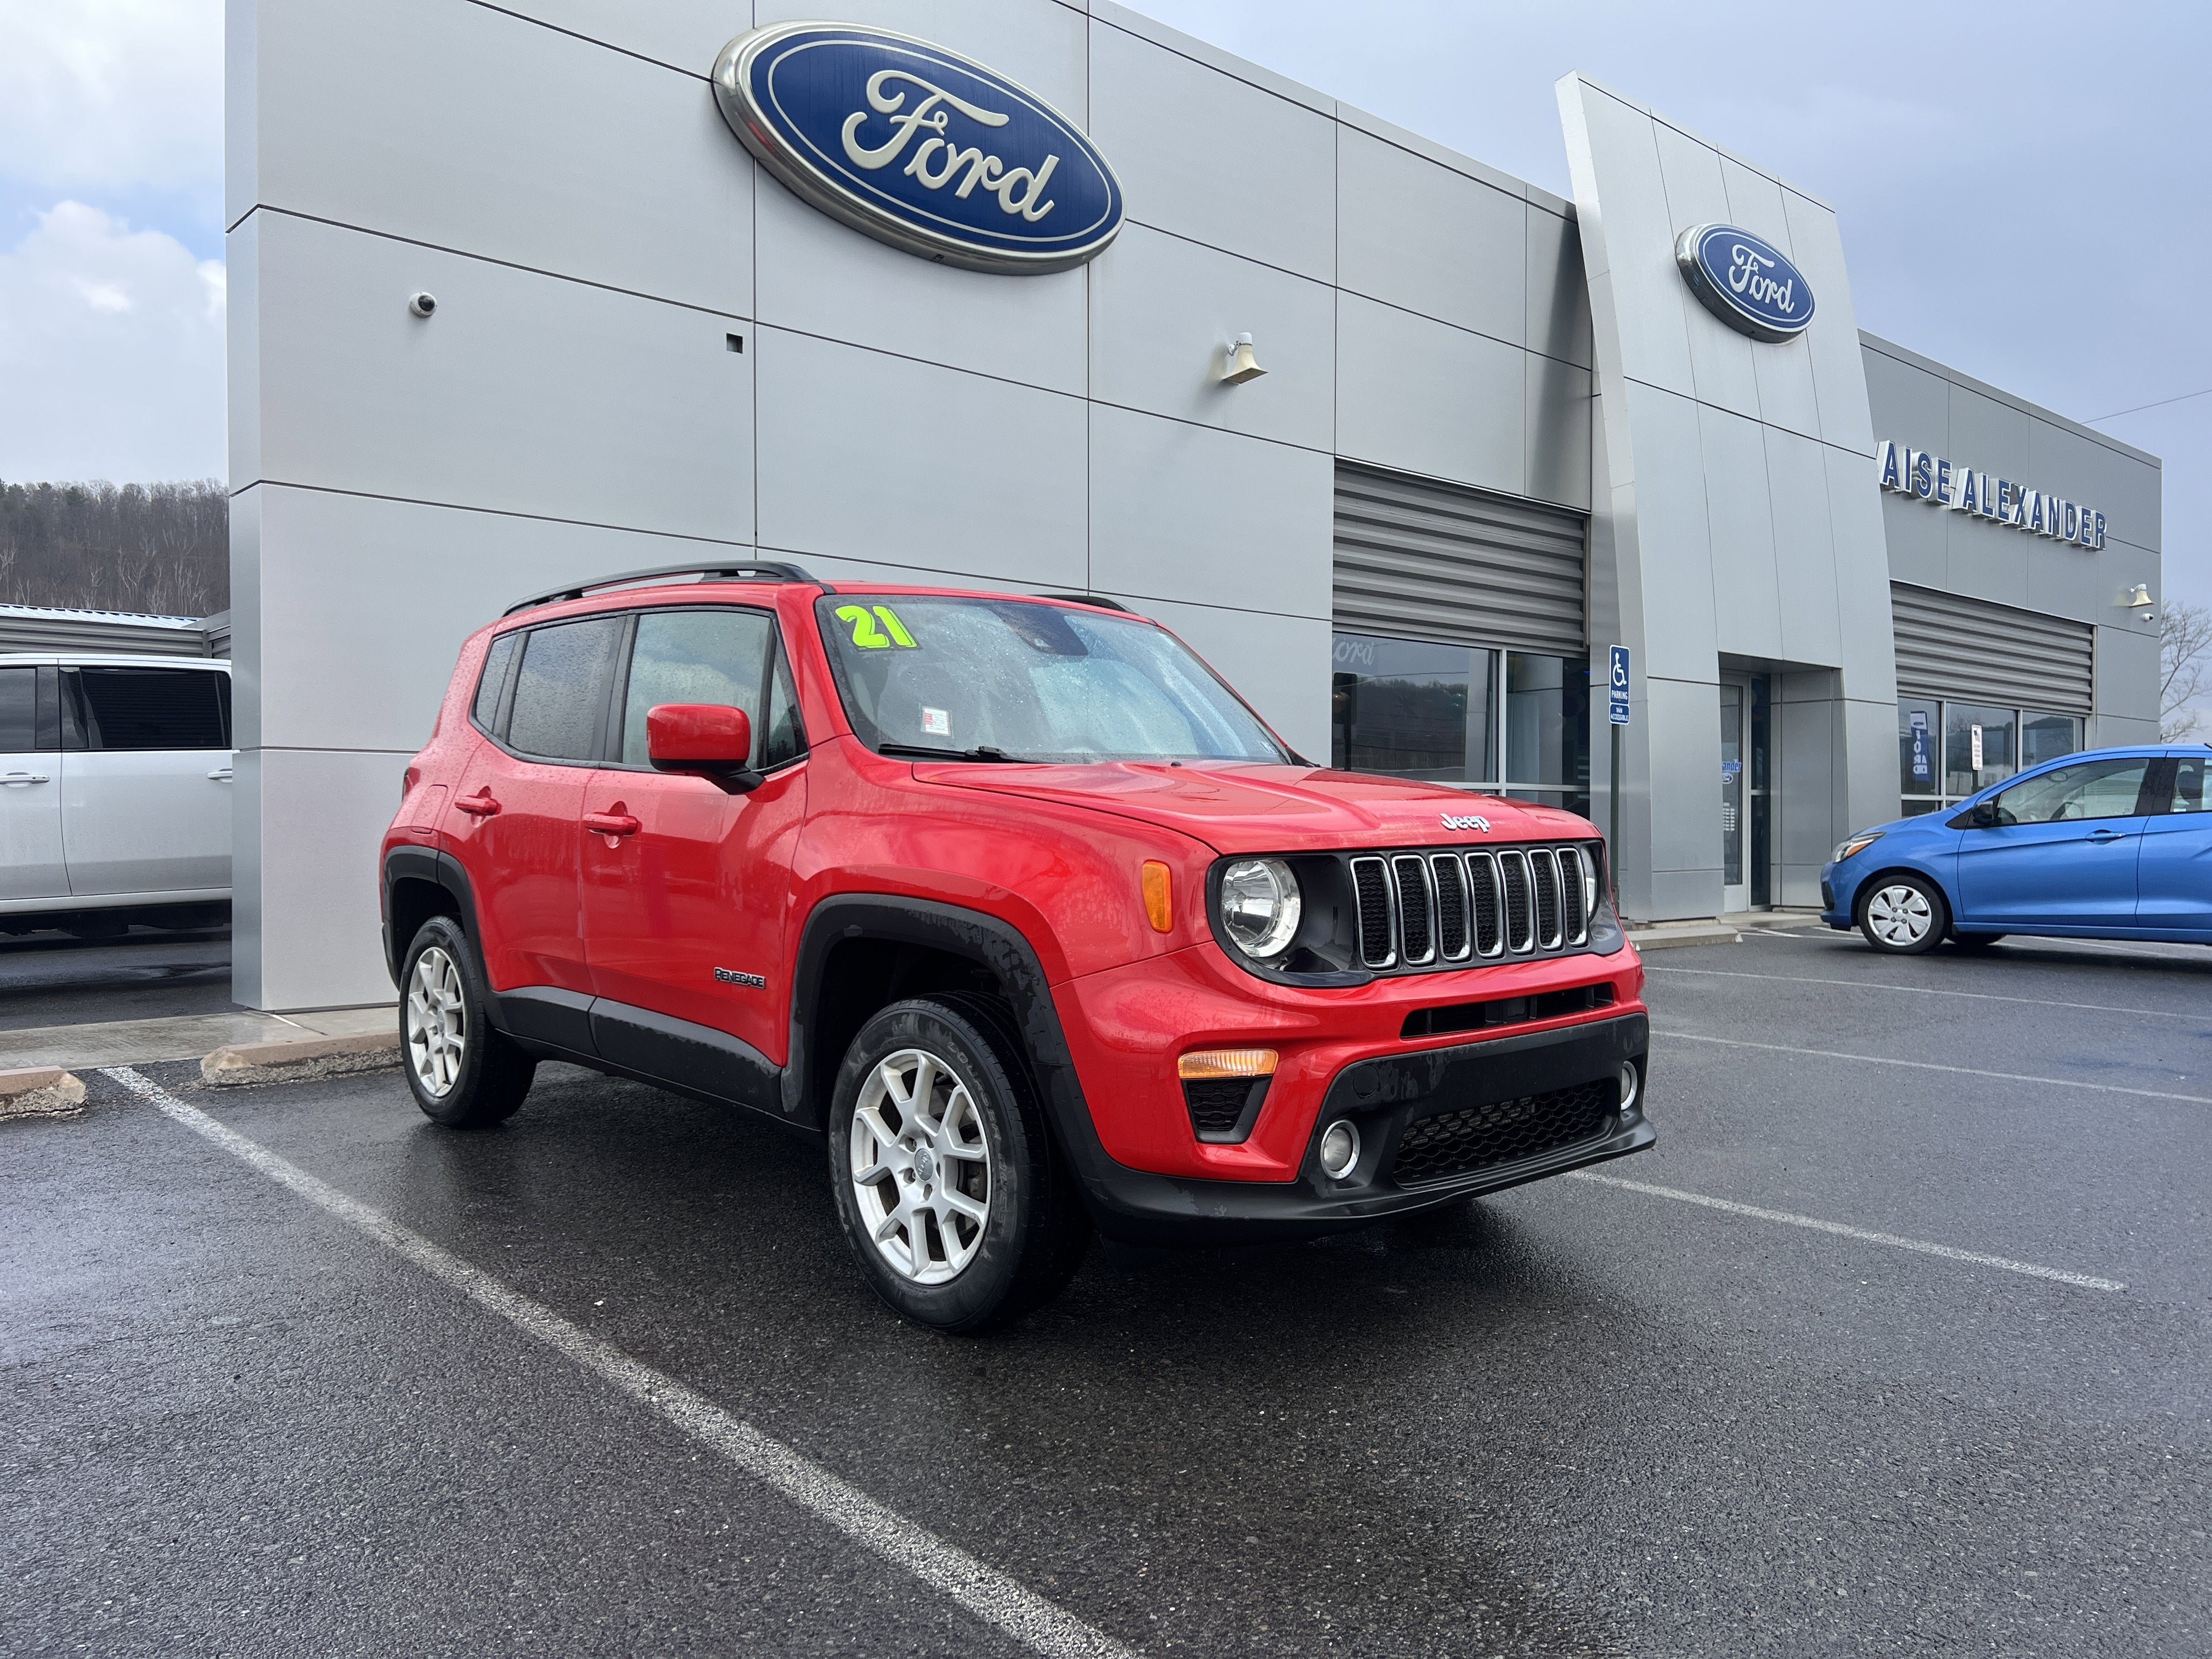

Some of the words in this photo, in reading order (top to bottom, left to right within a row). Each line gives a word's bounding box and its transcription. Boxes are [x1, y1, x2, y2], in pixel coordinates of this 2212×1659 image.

[842, 70, 1060, 222] Ford
[1728, 244, 1795, 314] Ford
[1878, 439, 1953, 505] AISE
[1960, 467, 2107, 549] ALEXANDER
[835, 605, 918, 648] 21
[1333, 637, 1375, 666] ord
[1611, 690, 1628, 700] PARKING
[1440, 813, 1491, 833] Jeep
[714, 967, 765, 989] RENEGADE
